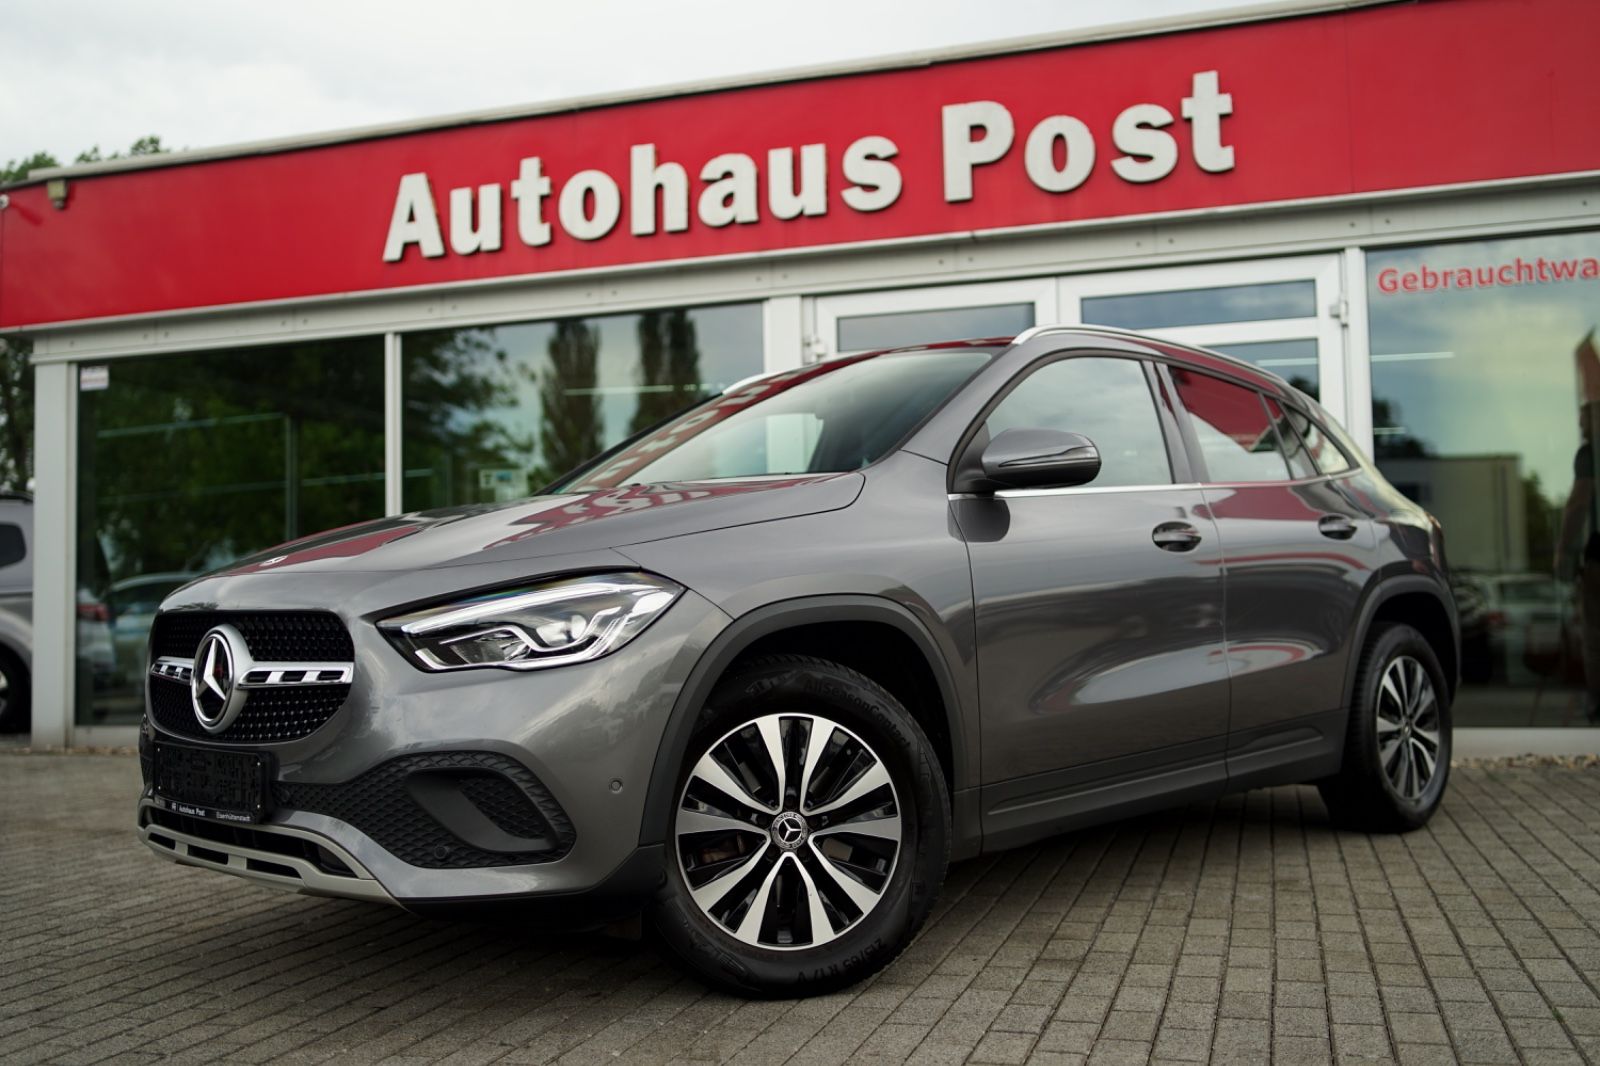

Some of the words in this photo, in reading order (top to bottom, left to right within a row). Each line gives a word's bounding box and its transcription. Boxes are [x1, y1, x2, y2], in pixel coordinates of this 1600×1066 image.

[382, 135, 902, 263] Autohaus
[942, 70, 1235, 203] Post
[1378, 256, 1600, 294] Gebrauchtwa
